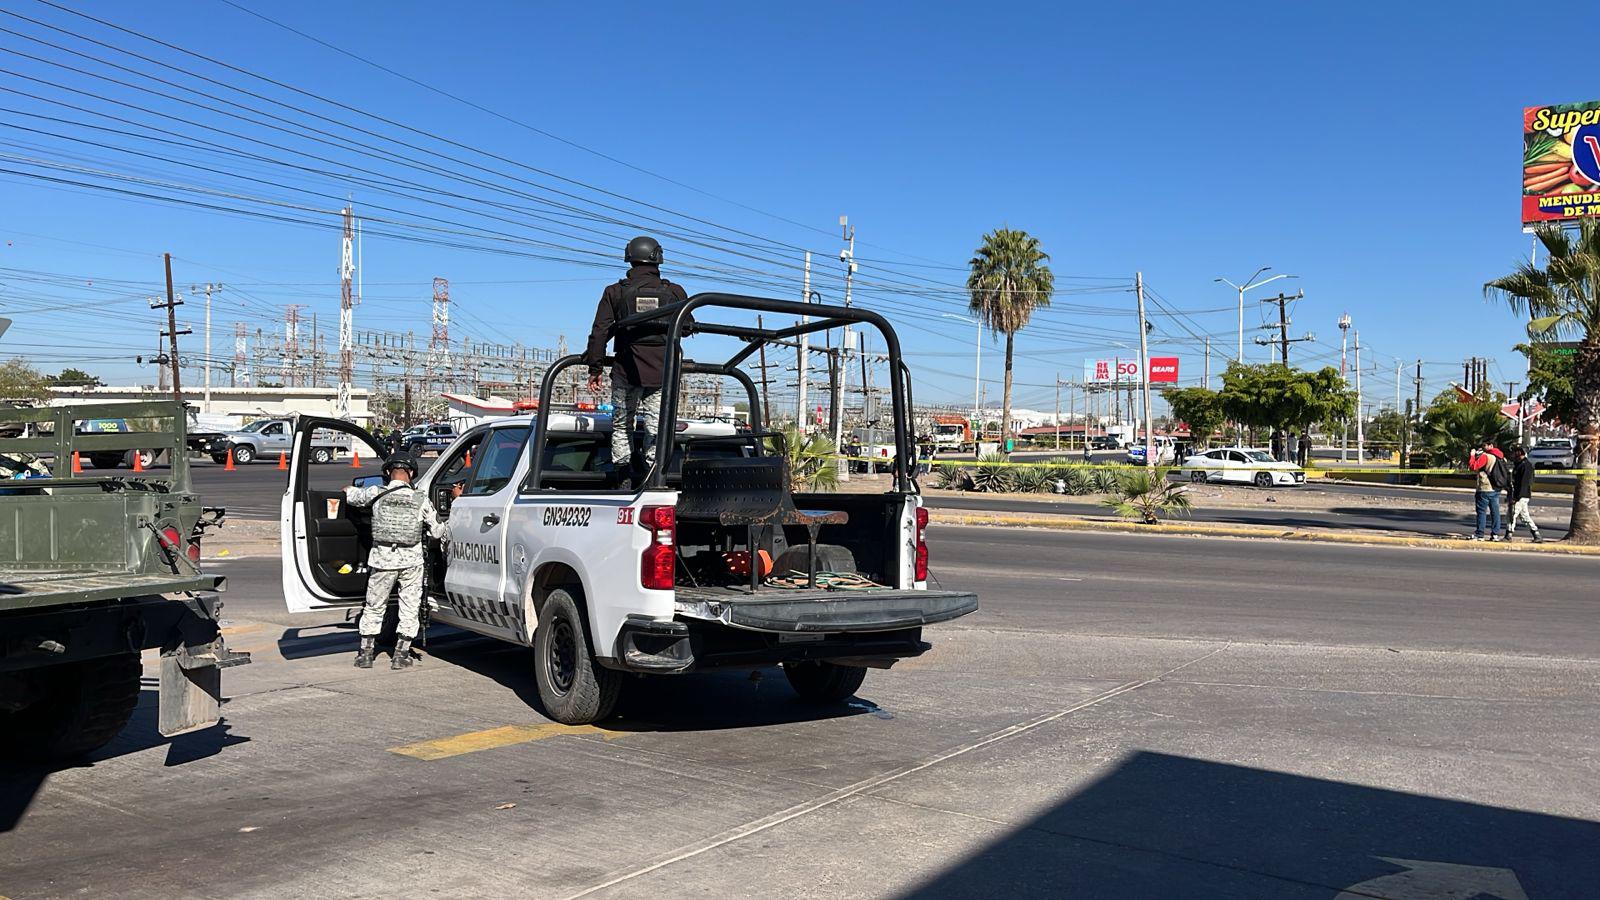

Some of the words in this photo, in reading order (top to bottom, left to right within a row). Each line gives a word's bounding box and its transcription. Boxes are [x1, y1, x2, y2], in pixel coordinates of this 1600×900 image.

[1563, 206, 1584, 217] DE
[1117, 363, 1137, 374] 50
[543, 507, 591, 526] GN342332
[617, 508, 634, 523] 911
[453, 542, 499, 564] NACIONAL
